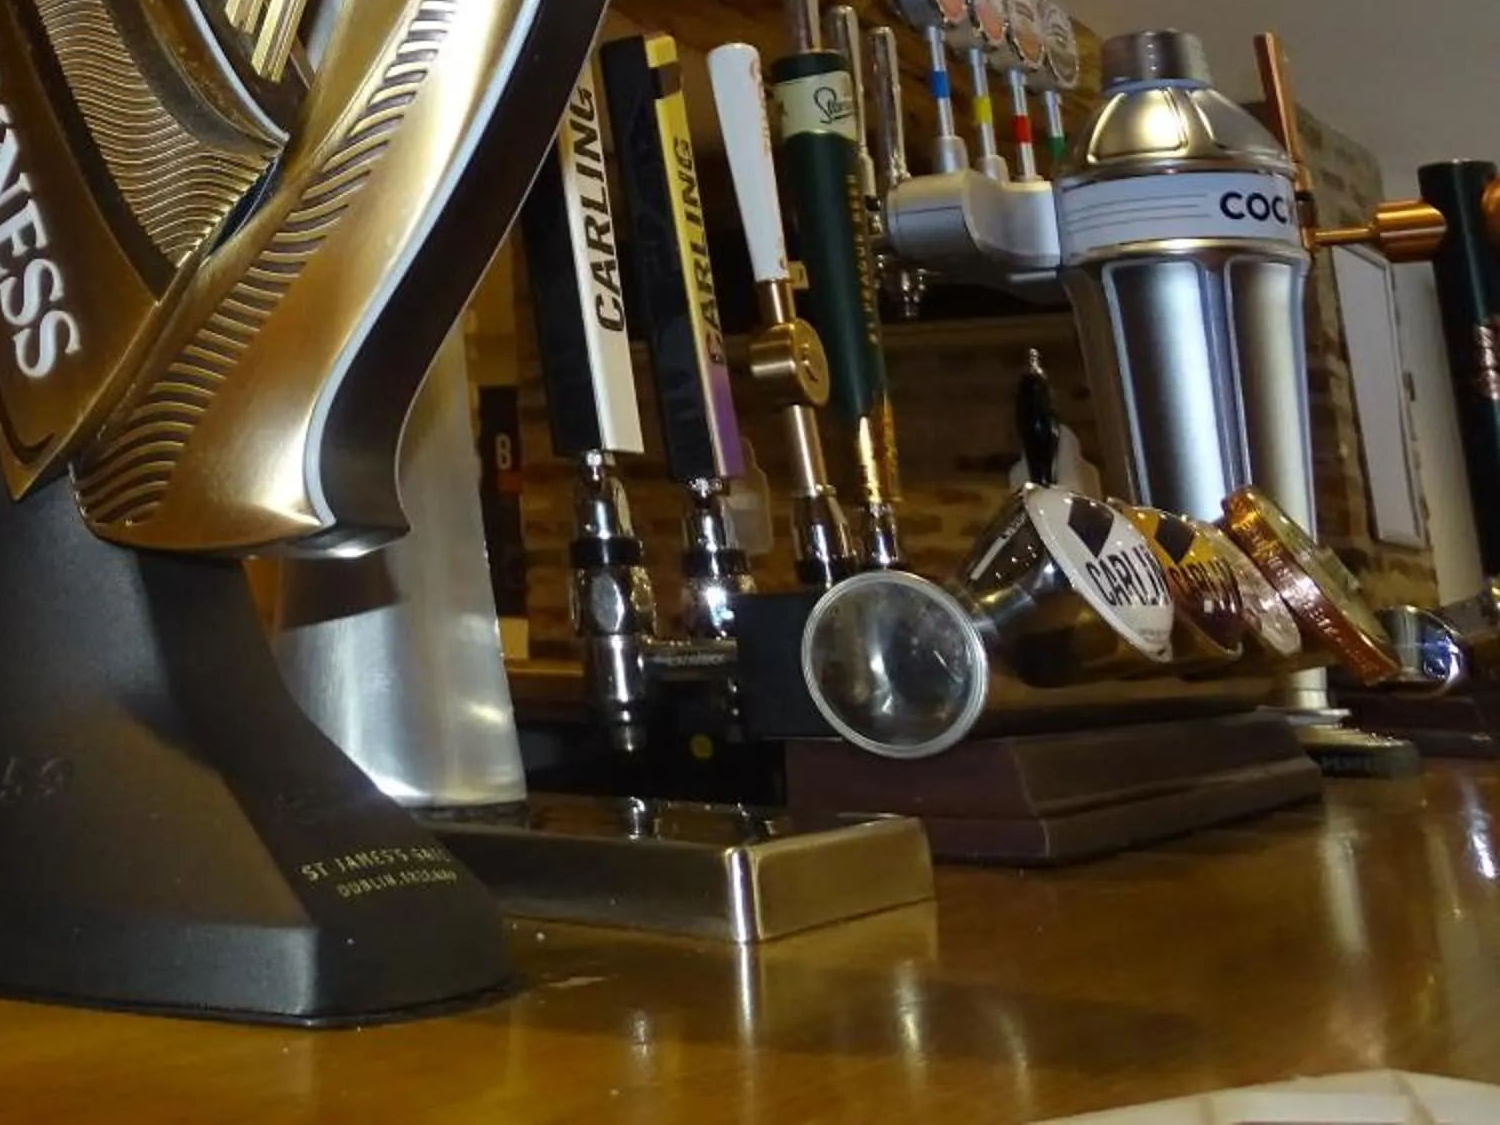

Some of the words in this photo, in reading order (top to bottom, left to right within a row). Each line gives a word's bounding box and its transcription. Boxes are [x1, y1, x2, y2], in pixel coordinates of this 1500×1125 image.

[569, 85, 625, 333] CARLING
[672, 136, 725, 365] CARLING
[1219, 190, 1294, 225] COC
[301, 861, 329, 882] ST
